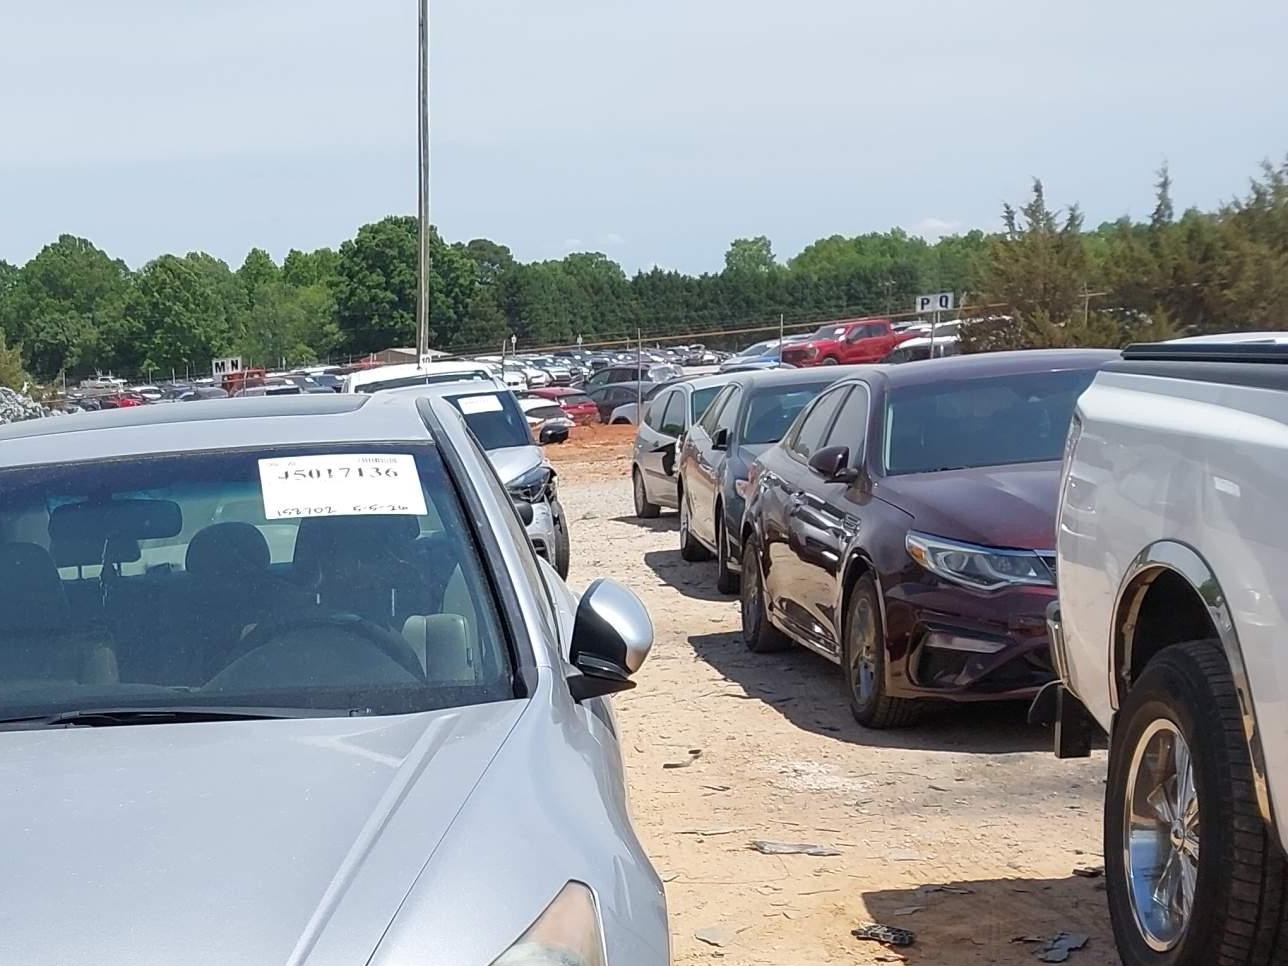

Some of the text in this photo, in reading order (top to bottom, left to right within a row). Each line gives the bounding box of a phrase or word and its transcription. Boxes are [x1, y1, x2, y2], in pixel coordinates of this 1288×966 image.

[920, 295, 949, 310] P Q
[215, 359, 239, 373] M N
